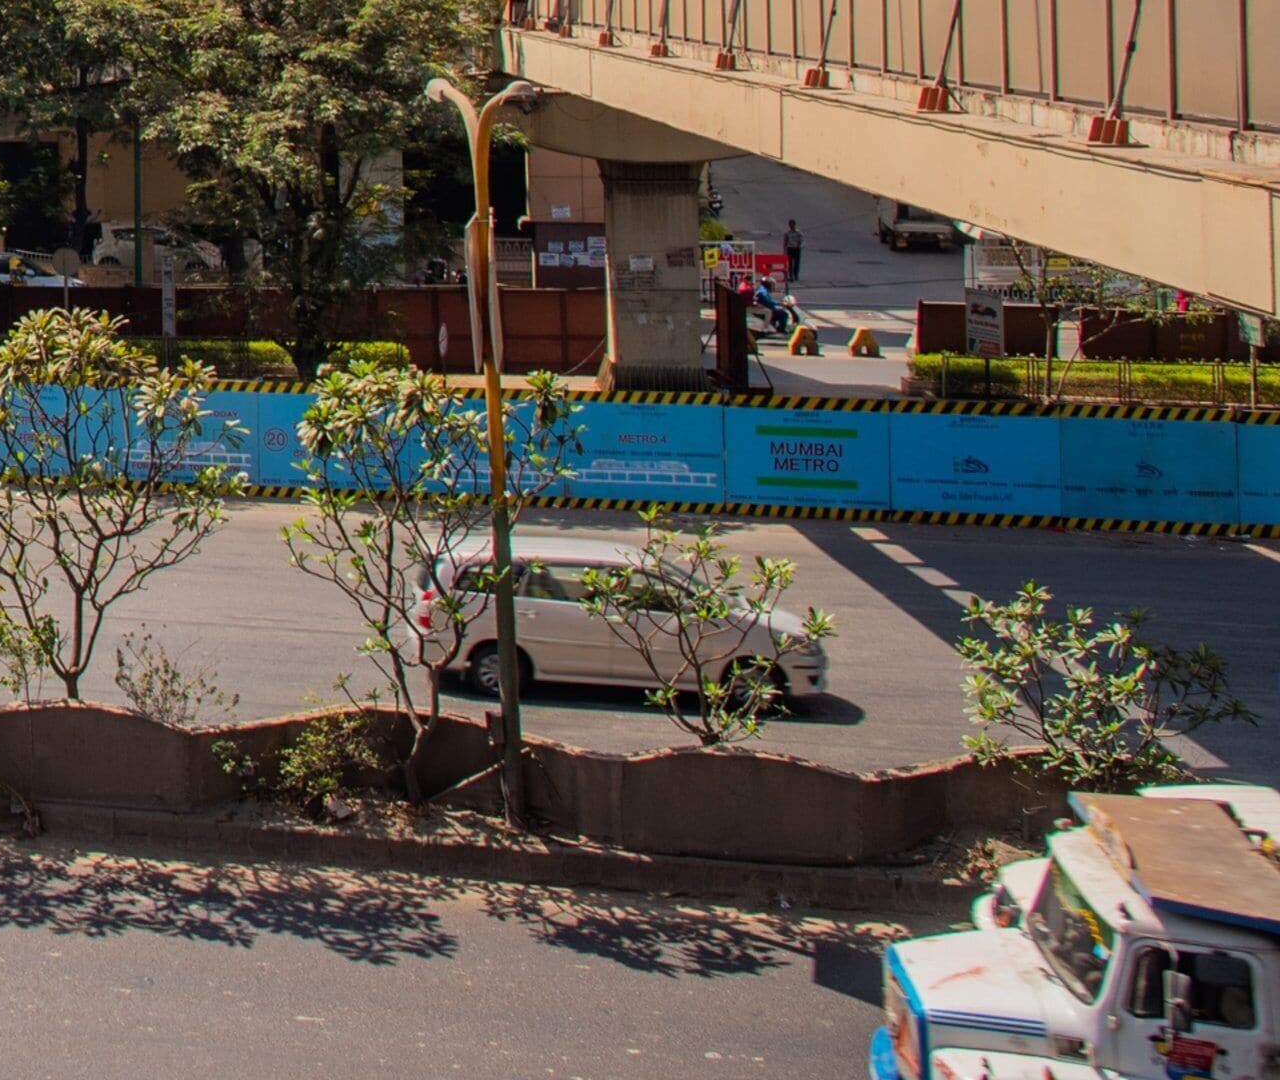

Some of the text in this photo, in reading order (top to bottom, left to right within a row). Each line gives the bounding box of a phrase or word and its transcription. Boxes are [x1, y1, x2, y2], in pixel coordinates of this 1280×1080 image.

[266, 431, 286, 443] 20
[618, 433, 668, 445] METRO 4
[769, 440, 844, 457] MUMBAI
[773, 457, 841, 473] METRO
